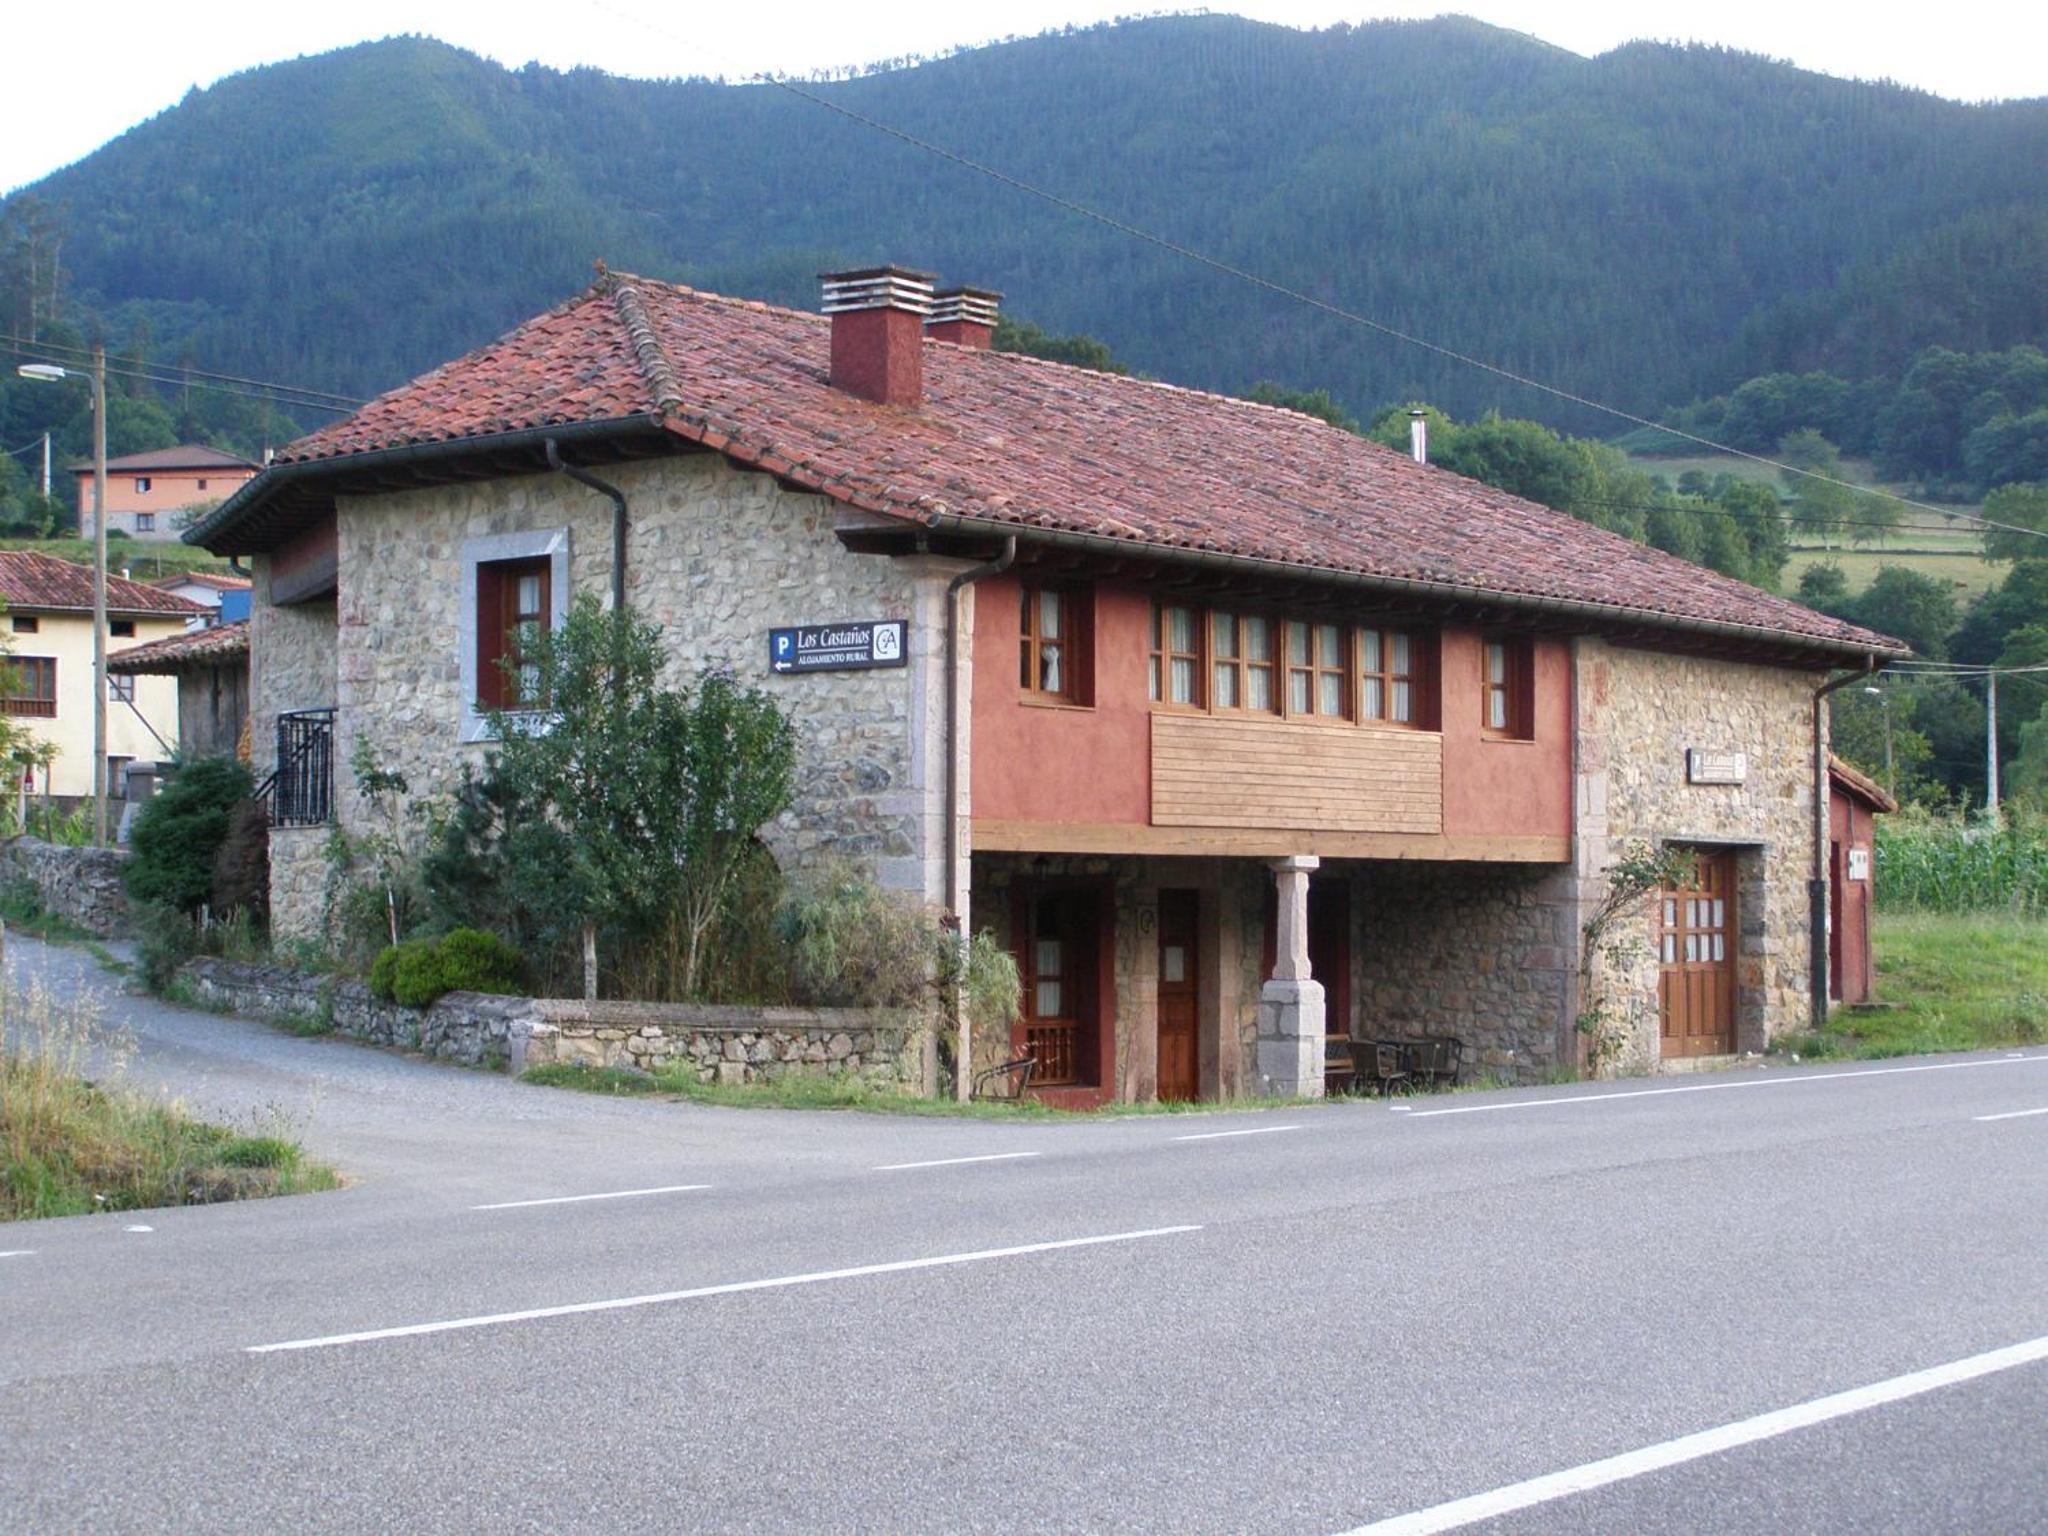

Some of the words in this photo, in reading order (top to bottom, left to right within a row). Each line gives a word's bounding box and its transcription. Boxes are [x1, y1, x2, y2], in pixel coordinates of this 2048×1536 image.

[778, 636, 789, 655] P
[798, 630, 817, 648] Los
[820, 626, 870, 646] Castaños
[798, 653, 845, 665] ALOJAMIENTO
[845, 651, 869, 662] RURAL
